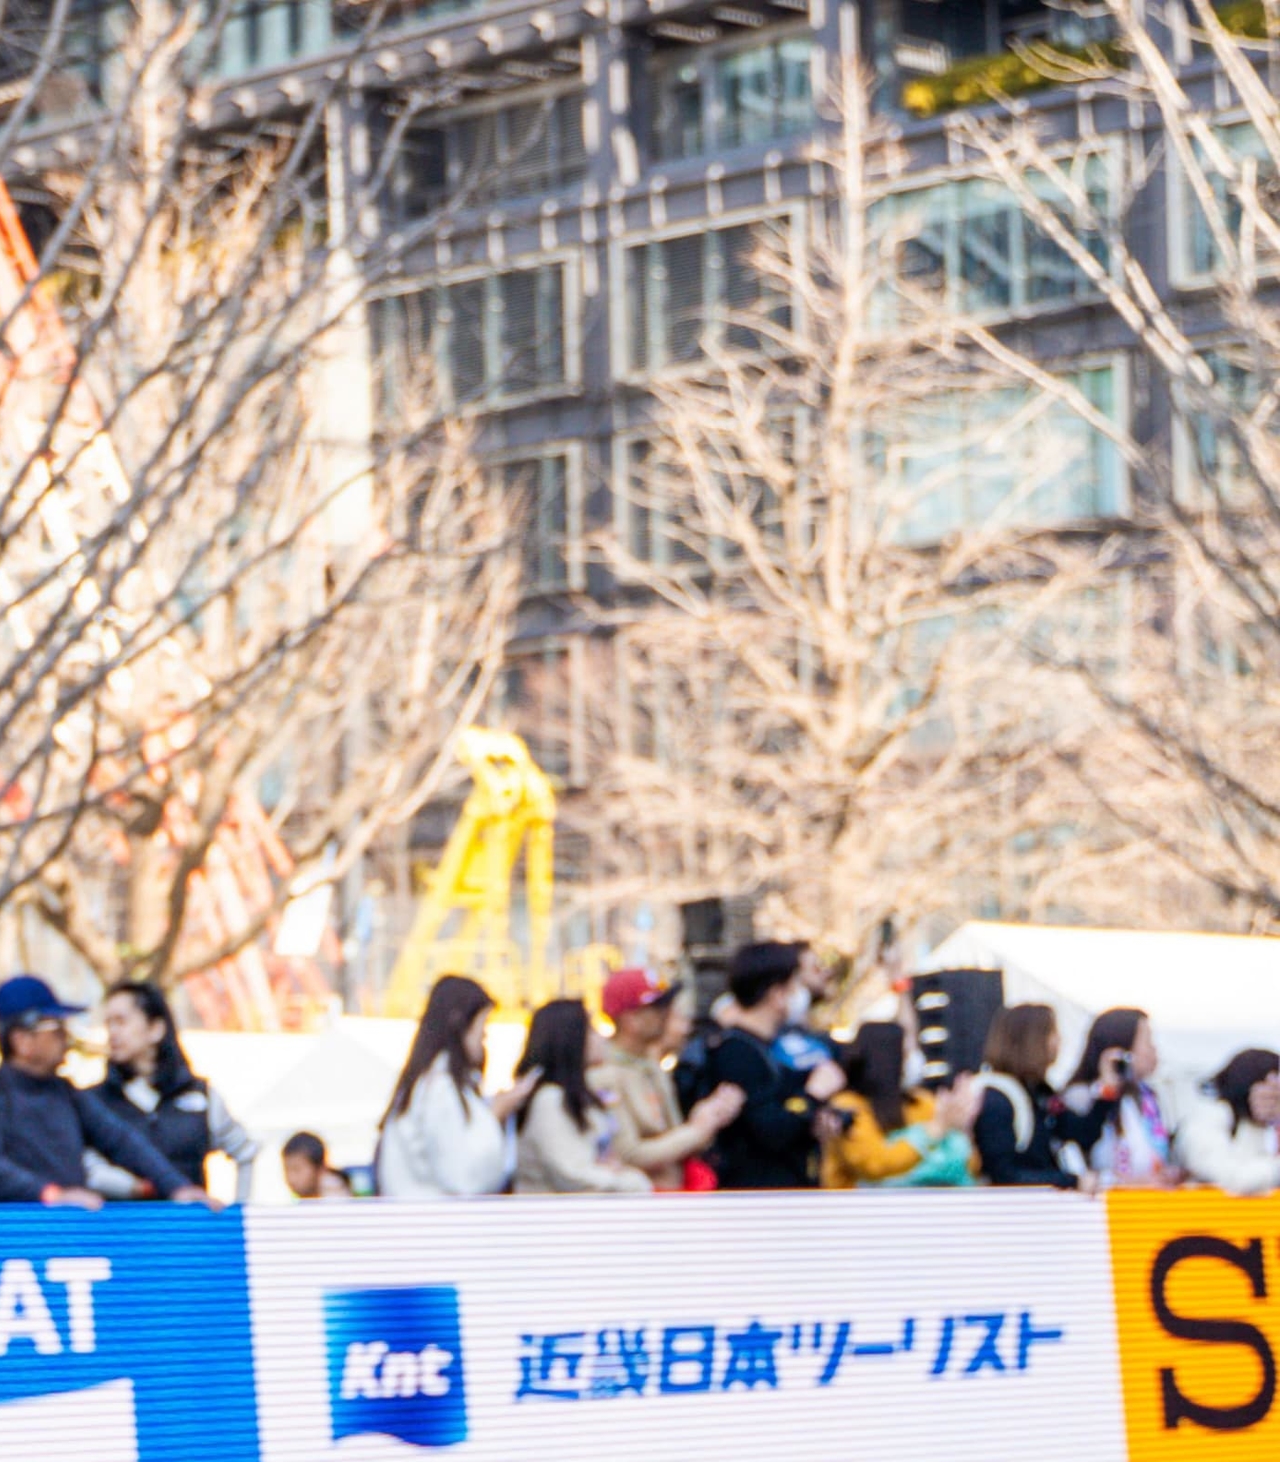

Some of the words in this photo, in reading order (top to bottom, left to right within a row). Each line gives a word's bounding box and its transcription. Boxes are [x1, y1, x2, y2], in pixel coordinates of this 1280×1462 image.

[339, 1341, 454, 1401] Knt
[515, 1310, 1065, 1403] 近畿日本ツーリスト
[1150, 1234, 1280, 1431] S
